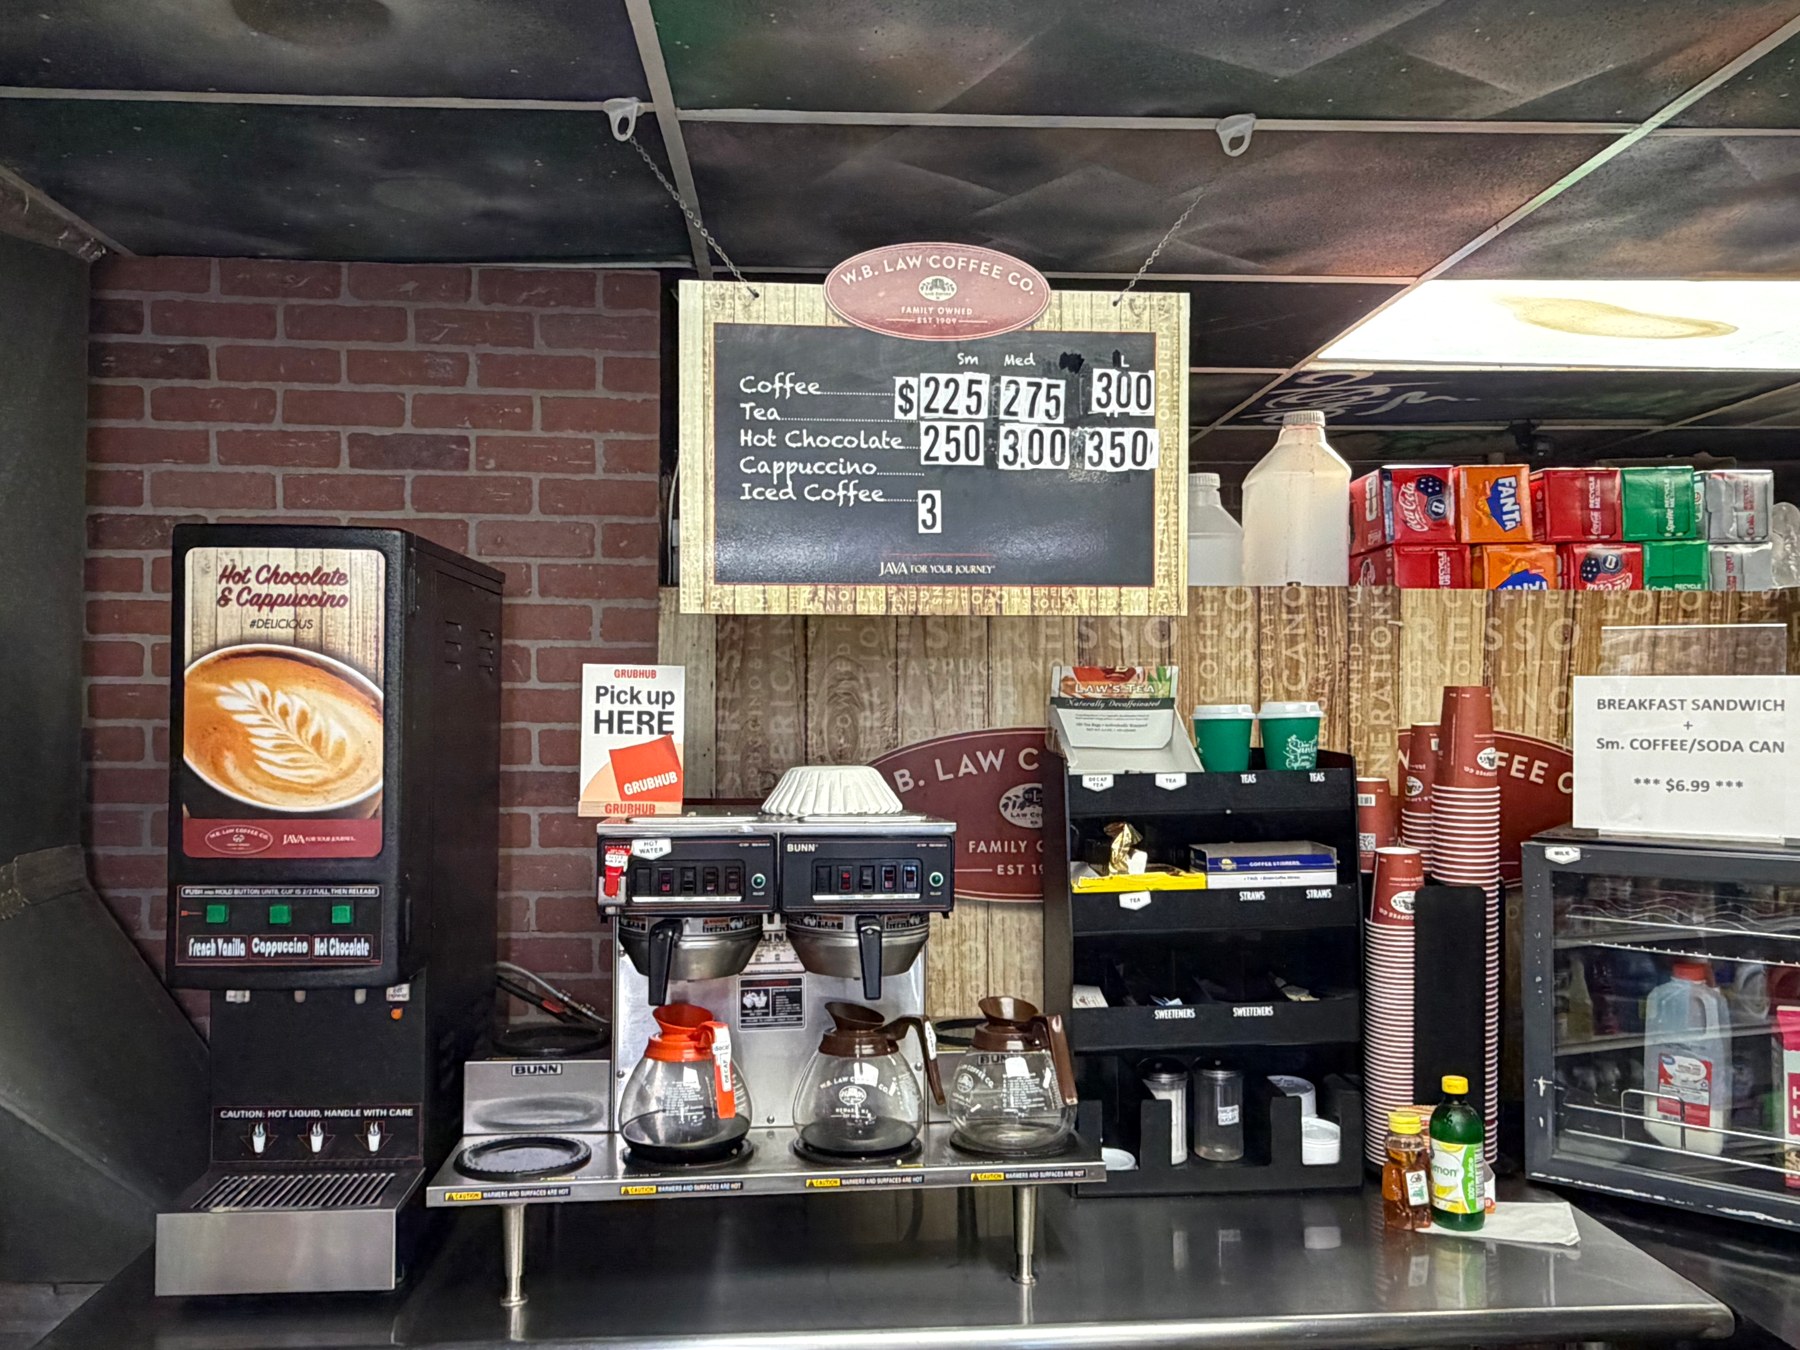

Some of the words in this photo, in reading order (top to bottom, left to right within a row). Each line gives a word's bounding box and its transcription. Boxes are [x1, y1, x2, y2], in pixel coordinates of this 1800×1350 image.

[840, 264, 879, 286] W.B.
[883, 255, 923, 273] LAW
[928, 255, 1003, 279] COFFEE
[1007, 271, 1035, 295] CO.
[901, 306, 934, 314] FAMILY
[937, 306, 973, 315] OWNED
[957, 352, 979, 366] Sm
[1003, 353, 1036, 367] Med
[739, 372, 821, 399] Coffee
[1003, 380, 1062, 418] 275
[1096, 372, 1152, 411] 300
[739, 401, 781, 421] Tea
[739, 430, 779, 449] Hot
[785, 430, 903, 450] Chocolate
[923, 424, 982, 461] 250
[1085, 428, 1149, 468] 350
[739, 457, 877, 486] Cappuccino
[739, 483, 797, 501] Iced
[803, 480, 884, 506] Coffee
[921, 494, 938, 530] 3
[1497, 476, 1522, 531] FANTA
[218, 564, 251, 585] Hot
[255, 564, 349, 586] Chocolate
[878, 561, 908, 577] JAVA
[910, 564, 928, 574] FOR
[930, 564, 953, 574] YOUR
[217, 587, 233, 608] &
[236, 586, 349, 613] Cappuccino
[249, 619, 313, 630] #DELICIOUS
[1409, 617, 1580, 652] RESSO
[1226, 586, 1254, 698] ESSO
[614, 669, 657, 679] GRUBHUB
[1370, 586, 1392, 772] NERATIONS
[1075, 684, 1120, 693] LAW'S
[1124, 684, 1155, 693] TEA
[595, 685, 643, 705] Pick
[647, 690, 675, 710] up
[1066, 699, 1105, 709] Naturally
[1108, 699, 1161, 709] Decaffeinated
[1597, 698, 1687, 712] BREAKFAST
[1691, 698, 1785, 712] SANDWICH
[594, 709, 675, 735] HERE
[1683, 720, 1693, 731] +
[1596, 738, 1626, 752] Sm.
[1630, 737, 1748, 753] COFFEE/SODA
[1751, 739, 1785, 753] CAN
[893, 768, 925, 793] B.
[934, 748, 1005, 782] LAW
[1496, 750, 1550, 785] FEE
[623, 771, 678, 796] GRUBHUB
[1240, 773, 1256, 784] TEAS
[1309, 772, 1325, 783] TEAS
[1666, 777, 1710, 794] $6.99
[604, 803, 656, 815] GRUBHUB
[282, 834, 305, 845] JAVA
[968, 840, 1028, 853] FAMILY
[787, 844, 815, 852] BUNN
[997, 864, 1025, 875] EST
[1239, 891, 1265, 901] STRAWS
[1306, 888, 1332, 899] STRAWS
[188, 937, 217, 957] French
[217, 937, 246, 957] Vanilla
[251, 937, 309, 957] Cappuccino
[314, 938, 328, 956] Hot
[329, 937, 370, 957] Chocolate
[1154, 1008, 1195, 1019] SWEETENERS
[1233, 1006, 1273, 1017] SWEETENERS
[515, 1064, 559, 1075] BUNN
[833, 1076, 848, 1084] LAW
[220, 1109, 265, 1118] CAUTION:
[267, 1109, 287, 1118] HOT
[289, 1109, 322, 1119] LIQUID,
[324, 1109, 361, 1117] HANDLE
[363, 1109, 387, 1117] WITH
[388, 1108, 414, 1117] CARE
[1064, 1170, 1074, 1178] ARE
[483, 1190, 508, 1198] WARMERS
[520, 1189, 547, 1197] SURFACES
[547, 1188, 558, 1196] ARE
[558, 1188, 570, 1196] HOT
[683, 1184, 694, 1192] AND
